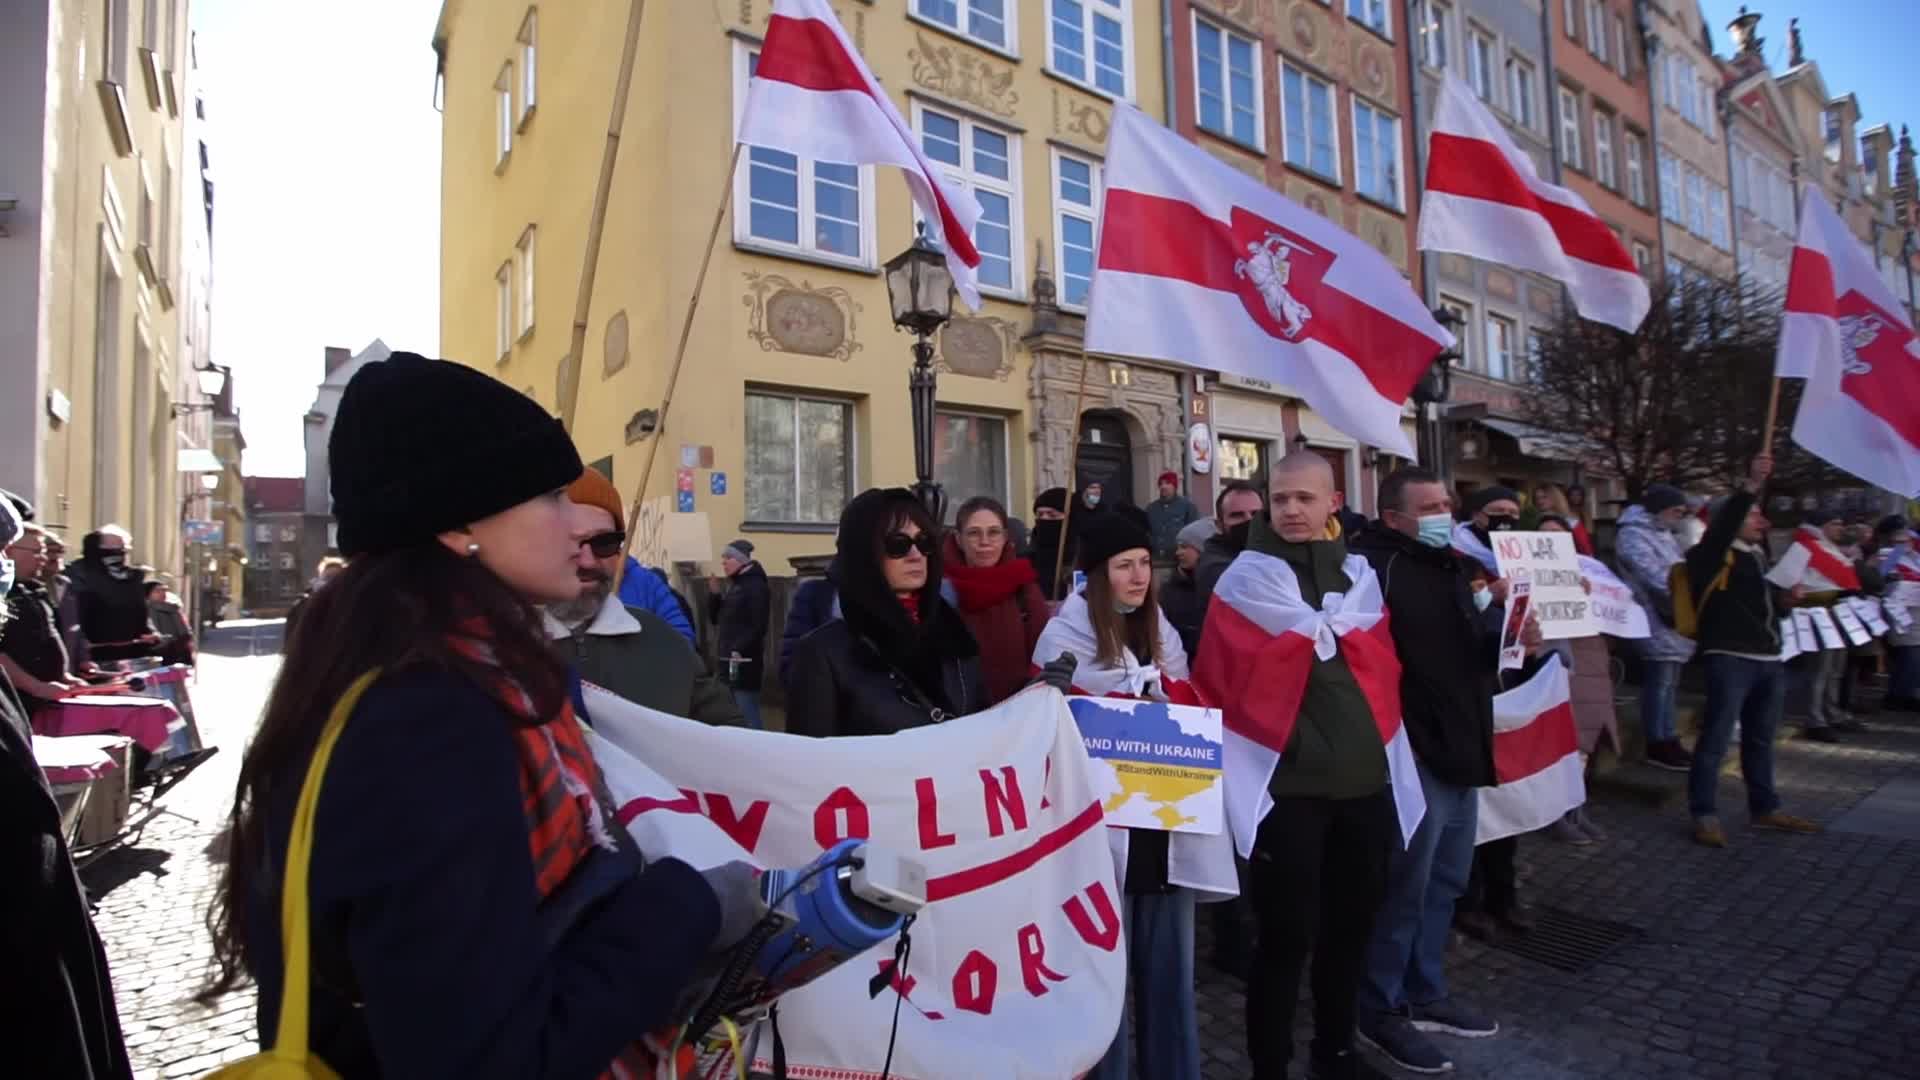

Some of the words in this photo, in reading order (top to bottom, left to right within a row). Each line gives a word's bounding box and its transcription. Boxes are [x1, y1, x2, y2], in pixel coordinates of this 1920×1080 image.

[1192, 399, 1205, 415] 12
[1498, 537, 1522, 560] NO
[1084, 738, 1112, 750] AND
[1115, 739, 1151, 754] WITH
[1154, 744, 1217, 761] UKRAINE
[1116, 764, 1216, 781] #StandWithUkraine
